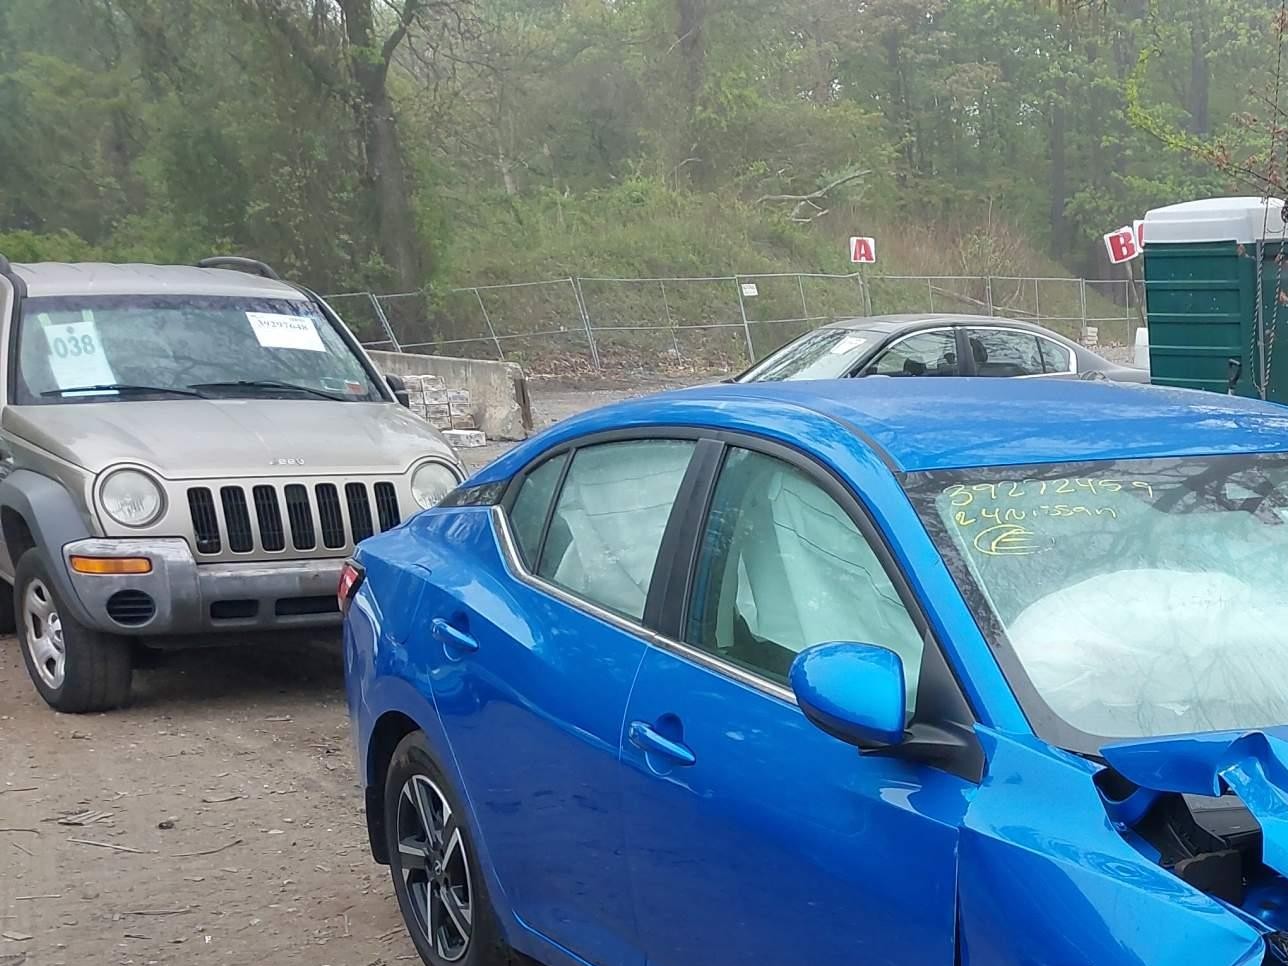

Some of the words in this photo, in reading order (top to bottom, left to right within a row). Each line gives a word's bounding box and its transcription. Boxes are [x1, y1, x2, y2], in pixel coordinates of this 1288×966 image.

[853, 239, 874, 261] A
[1109, 231, 1136, 261] B
[53, 334, 97, 358] 038
